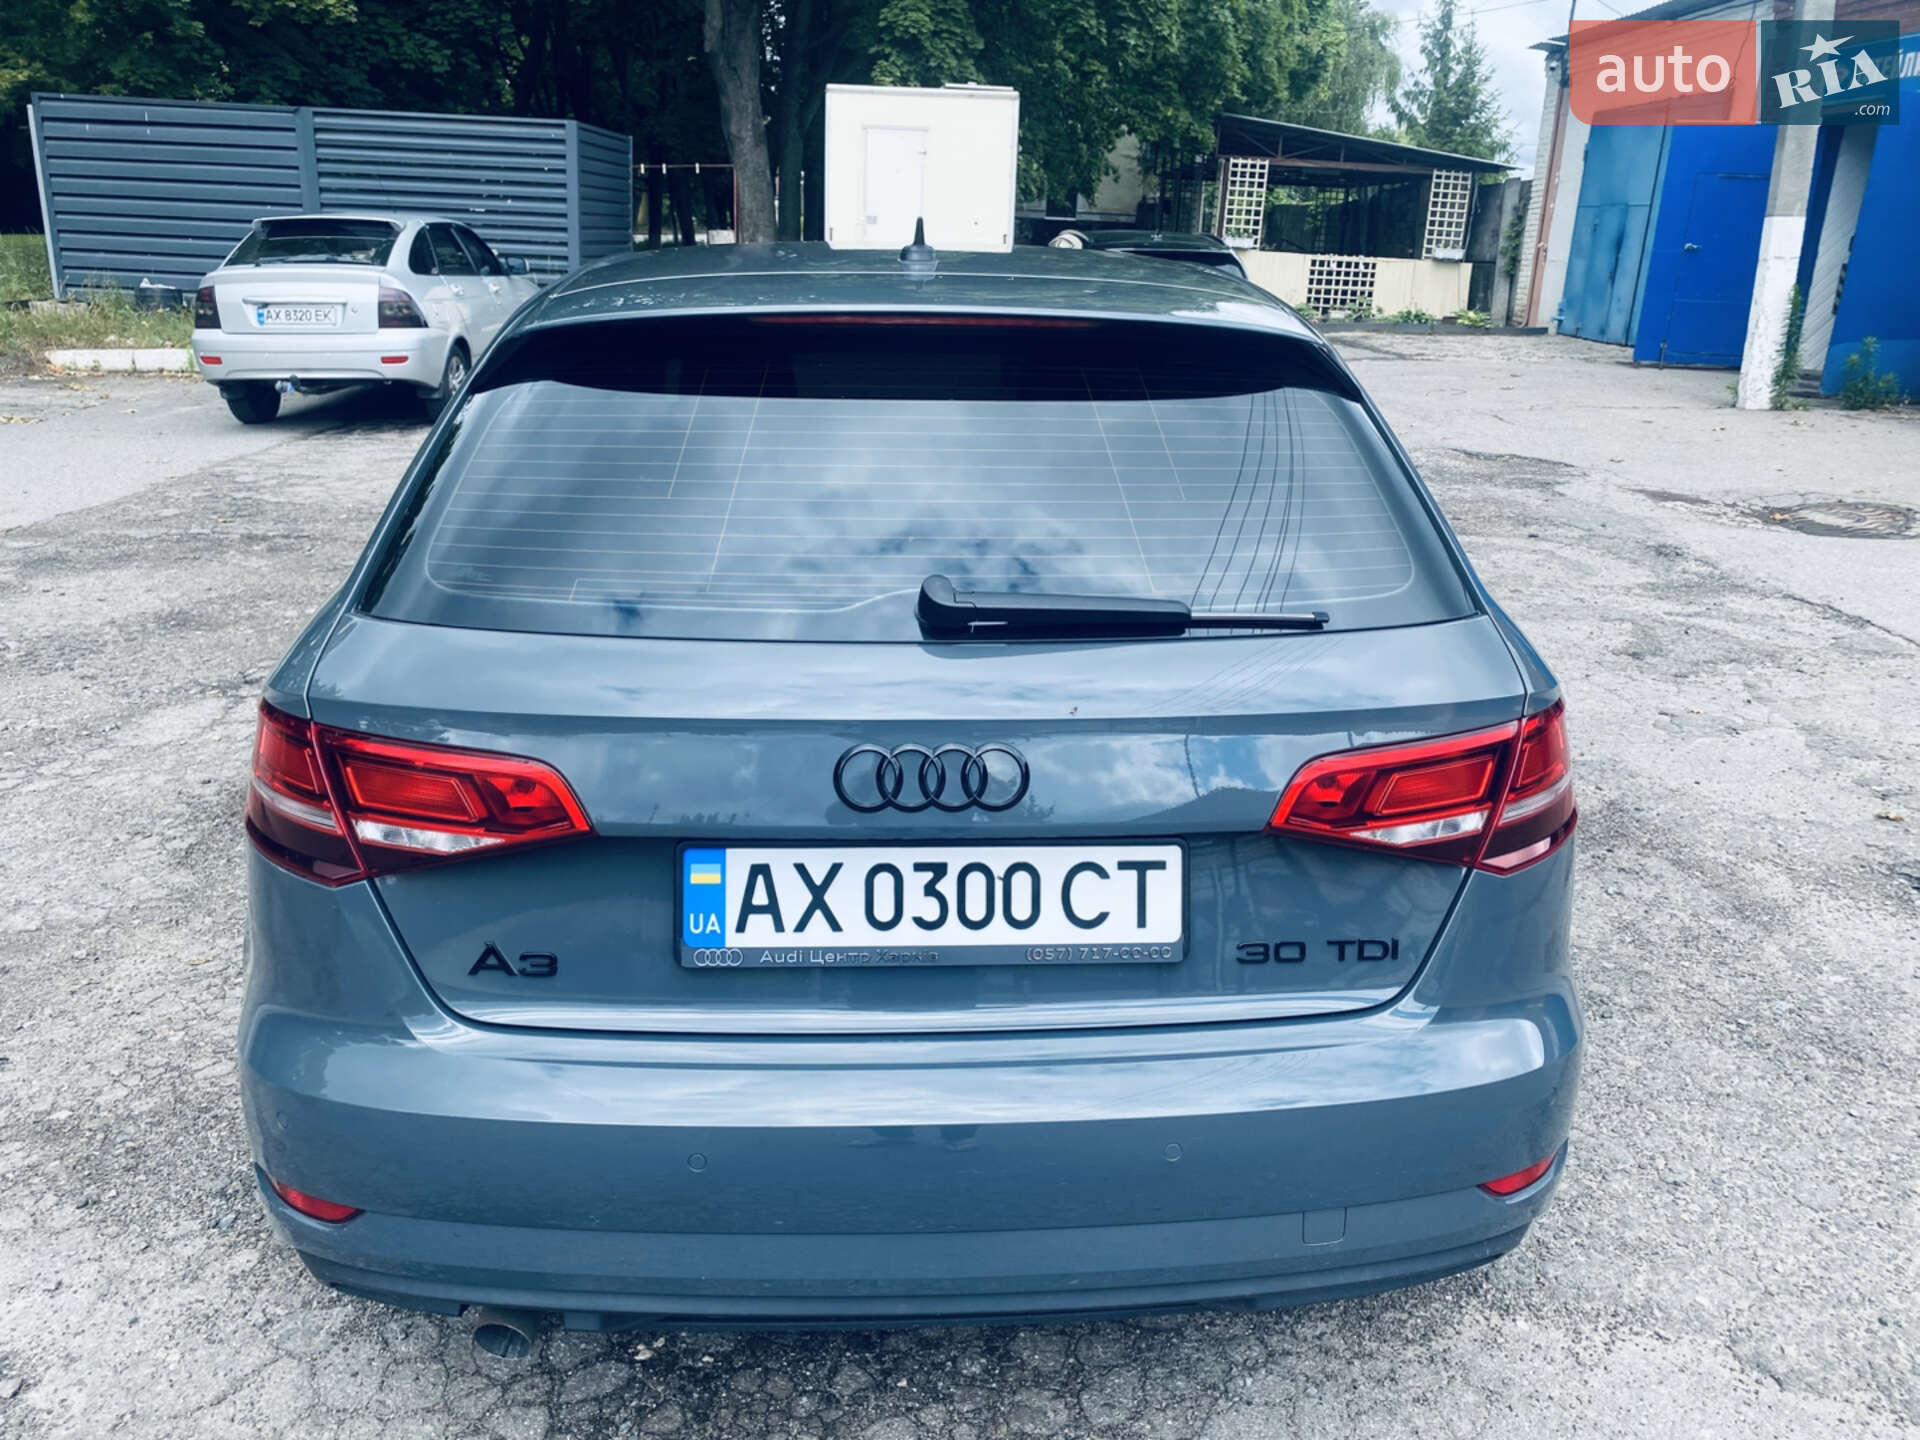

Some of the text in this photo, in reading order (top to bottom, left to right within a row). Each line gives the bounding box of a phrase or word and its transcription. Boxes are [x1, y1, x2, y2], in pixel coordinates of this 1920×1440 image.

[266, 309, 333, 321] AX 8320 EK
[734, 859, 1168, 933] AX 0300 CT
[688, 913, 722, 934] UA
[467, 941, 558, 978] A3
[759, 949, 803, 964] Audi
[809, 949, 871, 965] Центр
[1025, 946, 1073, 961] (057)
[1235, 937, 1399, 964] 30 TDI
